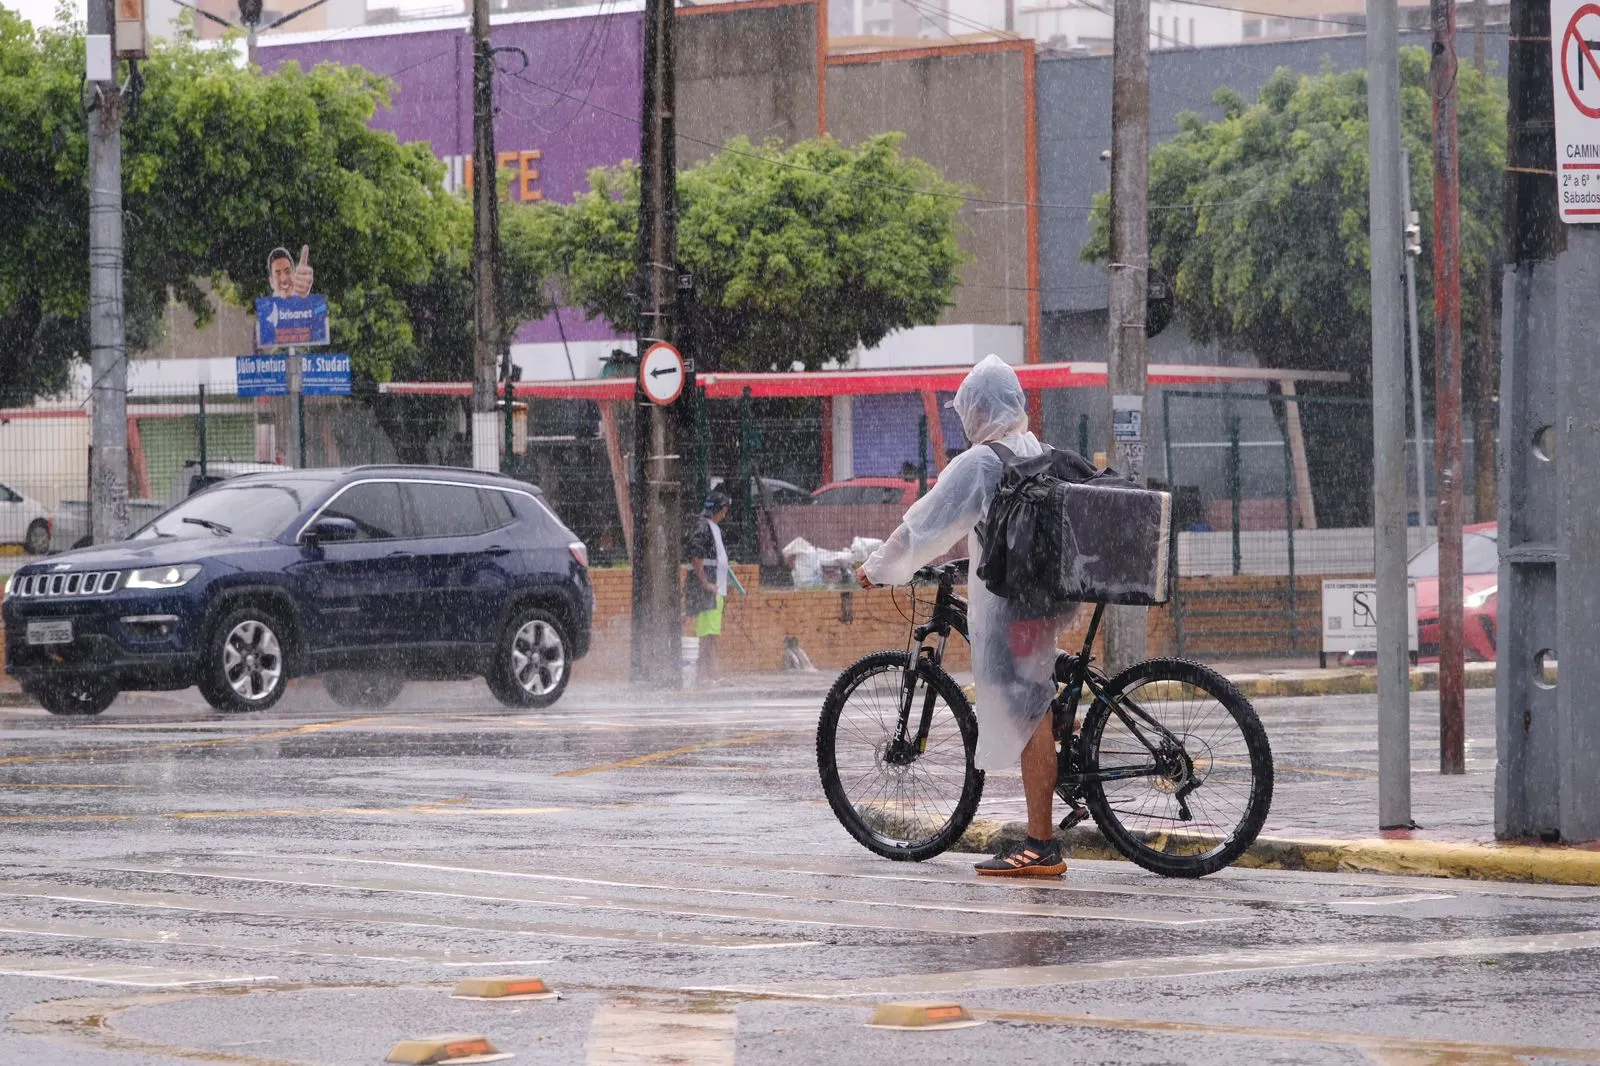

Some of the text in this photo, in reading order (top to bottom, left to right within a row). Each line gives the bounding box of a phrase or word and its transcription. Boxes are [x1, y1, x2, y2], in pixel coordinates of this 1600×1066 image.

[1566, 144, 1600, 158] CAMIN
[1574, 177, 1579, 187] a
[279, 308, 313, 320] brisanet
[256, 358, 286, 373] Ventura
[302, 356, 350, 372] Br. Studart
